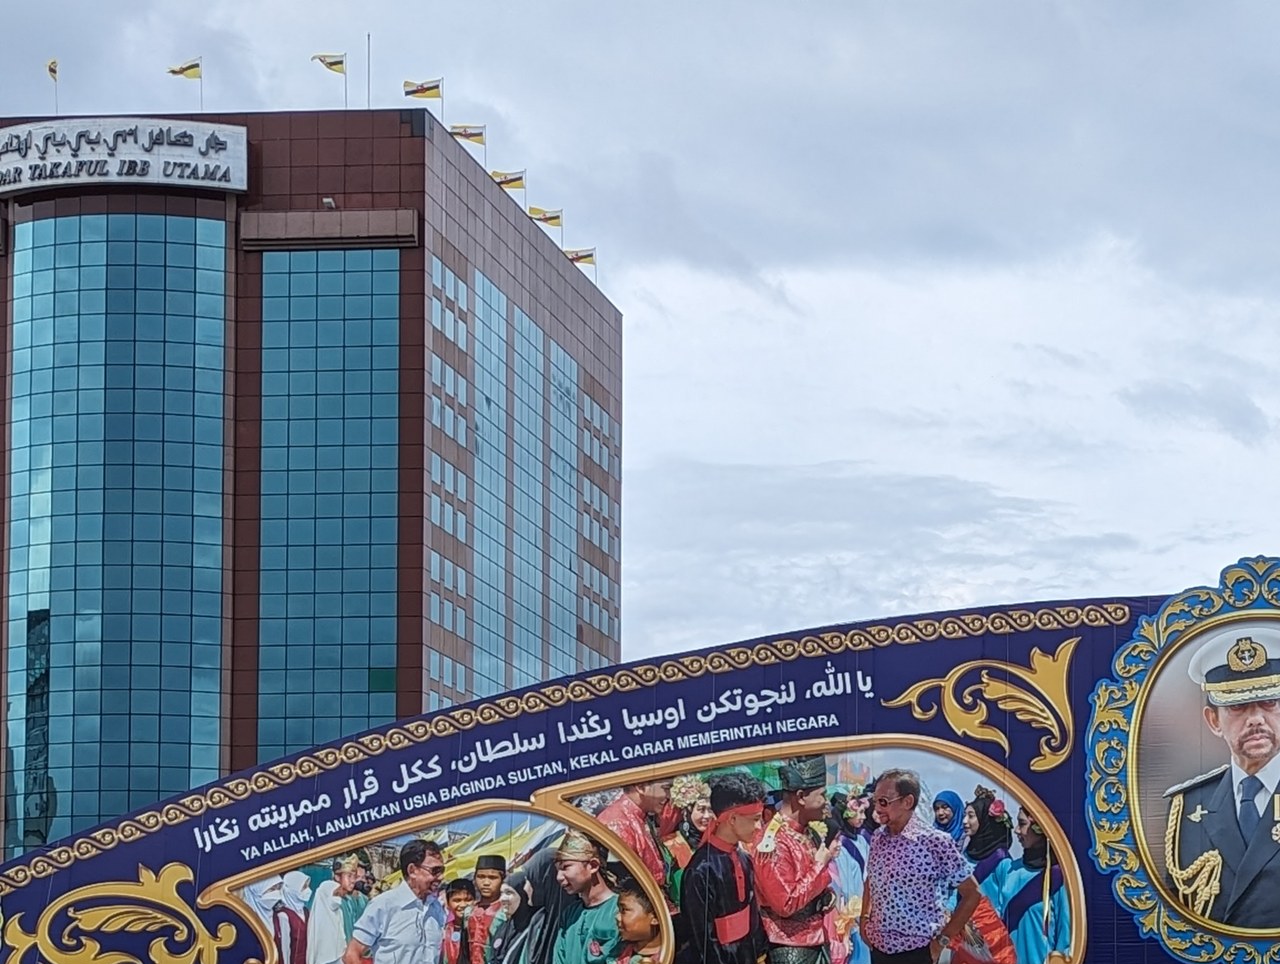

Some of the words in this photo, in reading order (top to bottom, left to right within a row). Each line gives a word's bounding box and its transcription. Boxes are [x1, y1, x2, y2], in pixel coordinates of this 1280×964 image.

[28, 159, 110, 182] TAKAFUL
[116, 158, 151, 177] IBB
[162, 159, 232, 183] UTAMA
[856, 670, 875, 699] يا
[621, 698, 686, 736] اوسيا
[240, 845, 262, 862] YA
[263, 828, 315, 855] ALLAH,
[315, 802, 401, 838] LANJUTKAN
[402, 791, 438, 812] USIA
[439, 774, 506, 803] BAGINDA
[507, 760, 568, 786] SULTAN,
[569, 749, 620, 771] KEKAL
[621, 738, 675, 761] QARAR
[677, 722, 773, 750] MEMERINTAH
[776, 713, 840, 735] NEGARA
